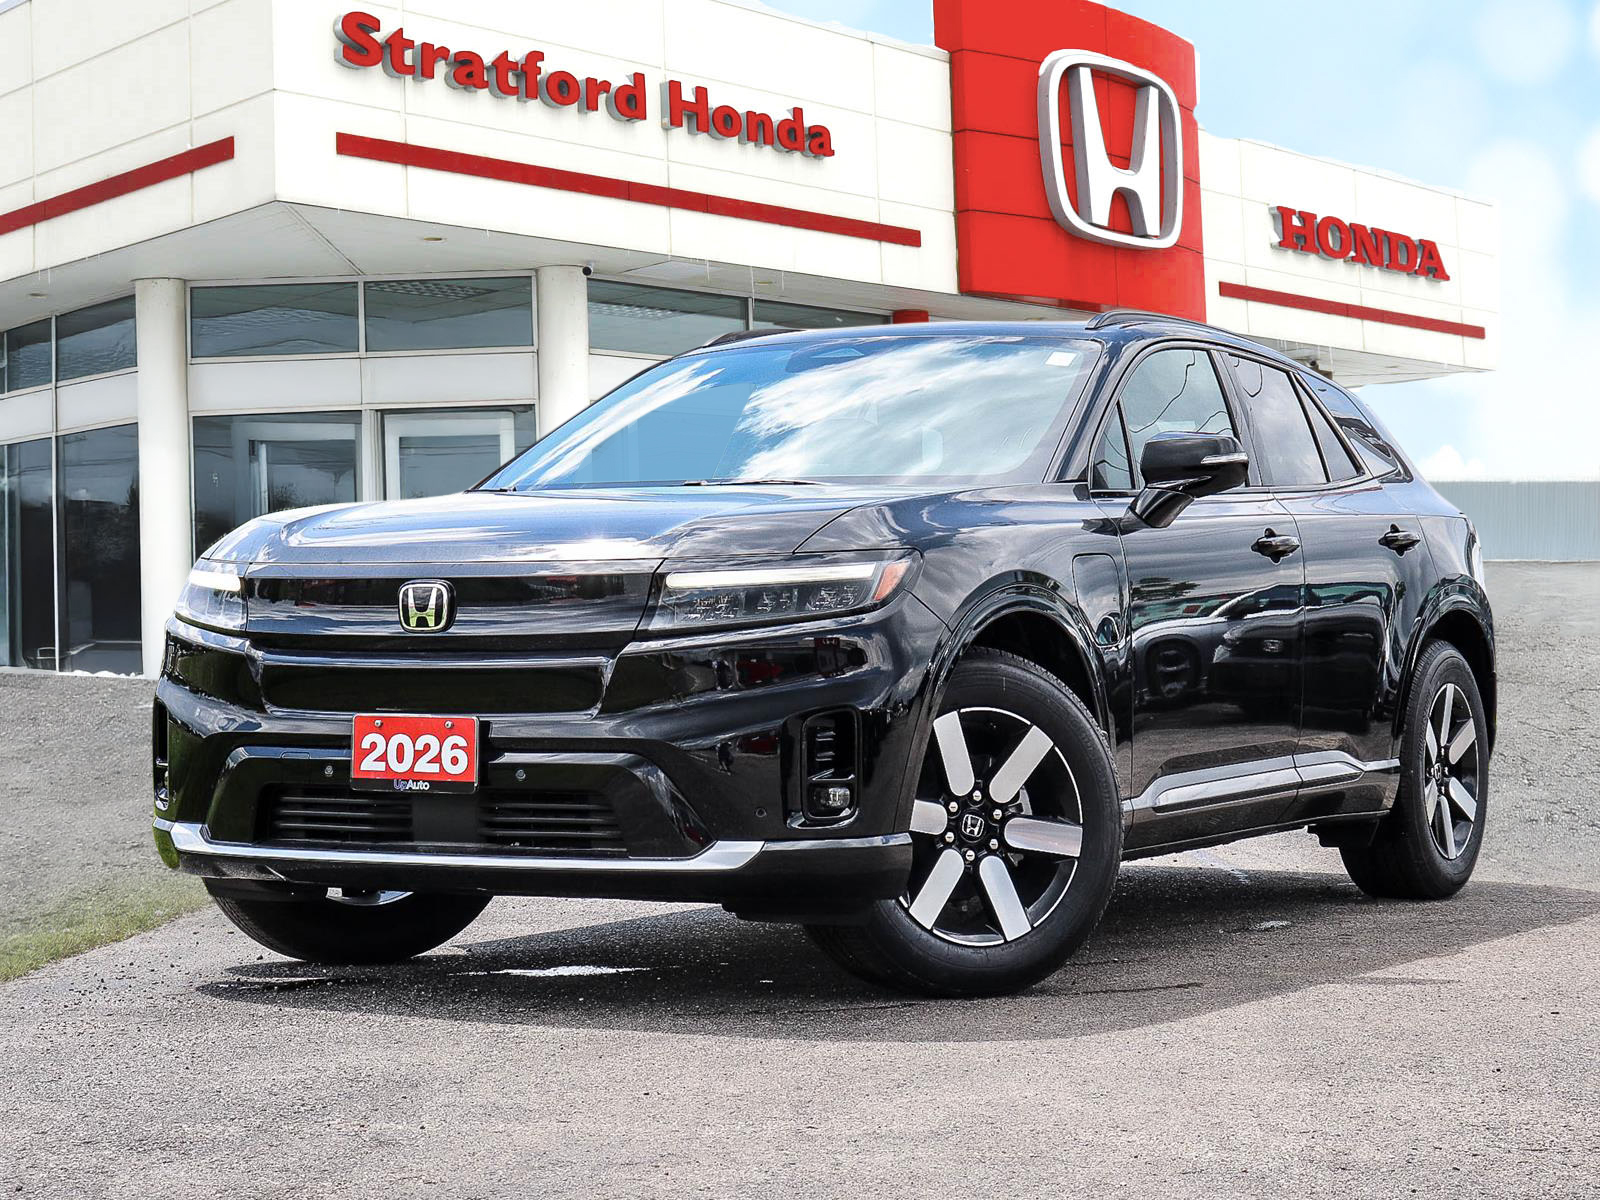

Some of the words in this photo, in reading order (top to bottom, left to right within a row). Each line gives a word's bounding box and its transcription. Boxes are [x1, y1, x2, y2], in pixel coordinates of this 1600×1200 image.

[334, 11, 647, 121] Stratford
[661, 79, 835, 158] Honda
[1269, 205, 1450, 282] HONDA
[359, 732, 469, 776] 2026
[393, 778, 430, 791] UpAuto
